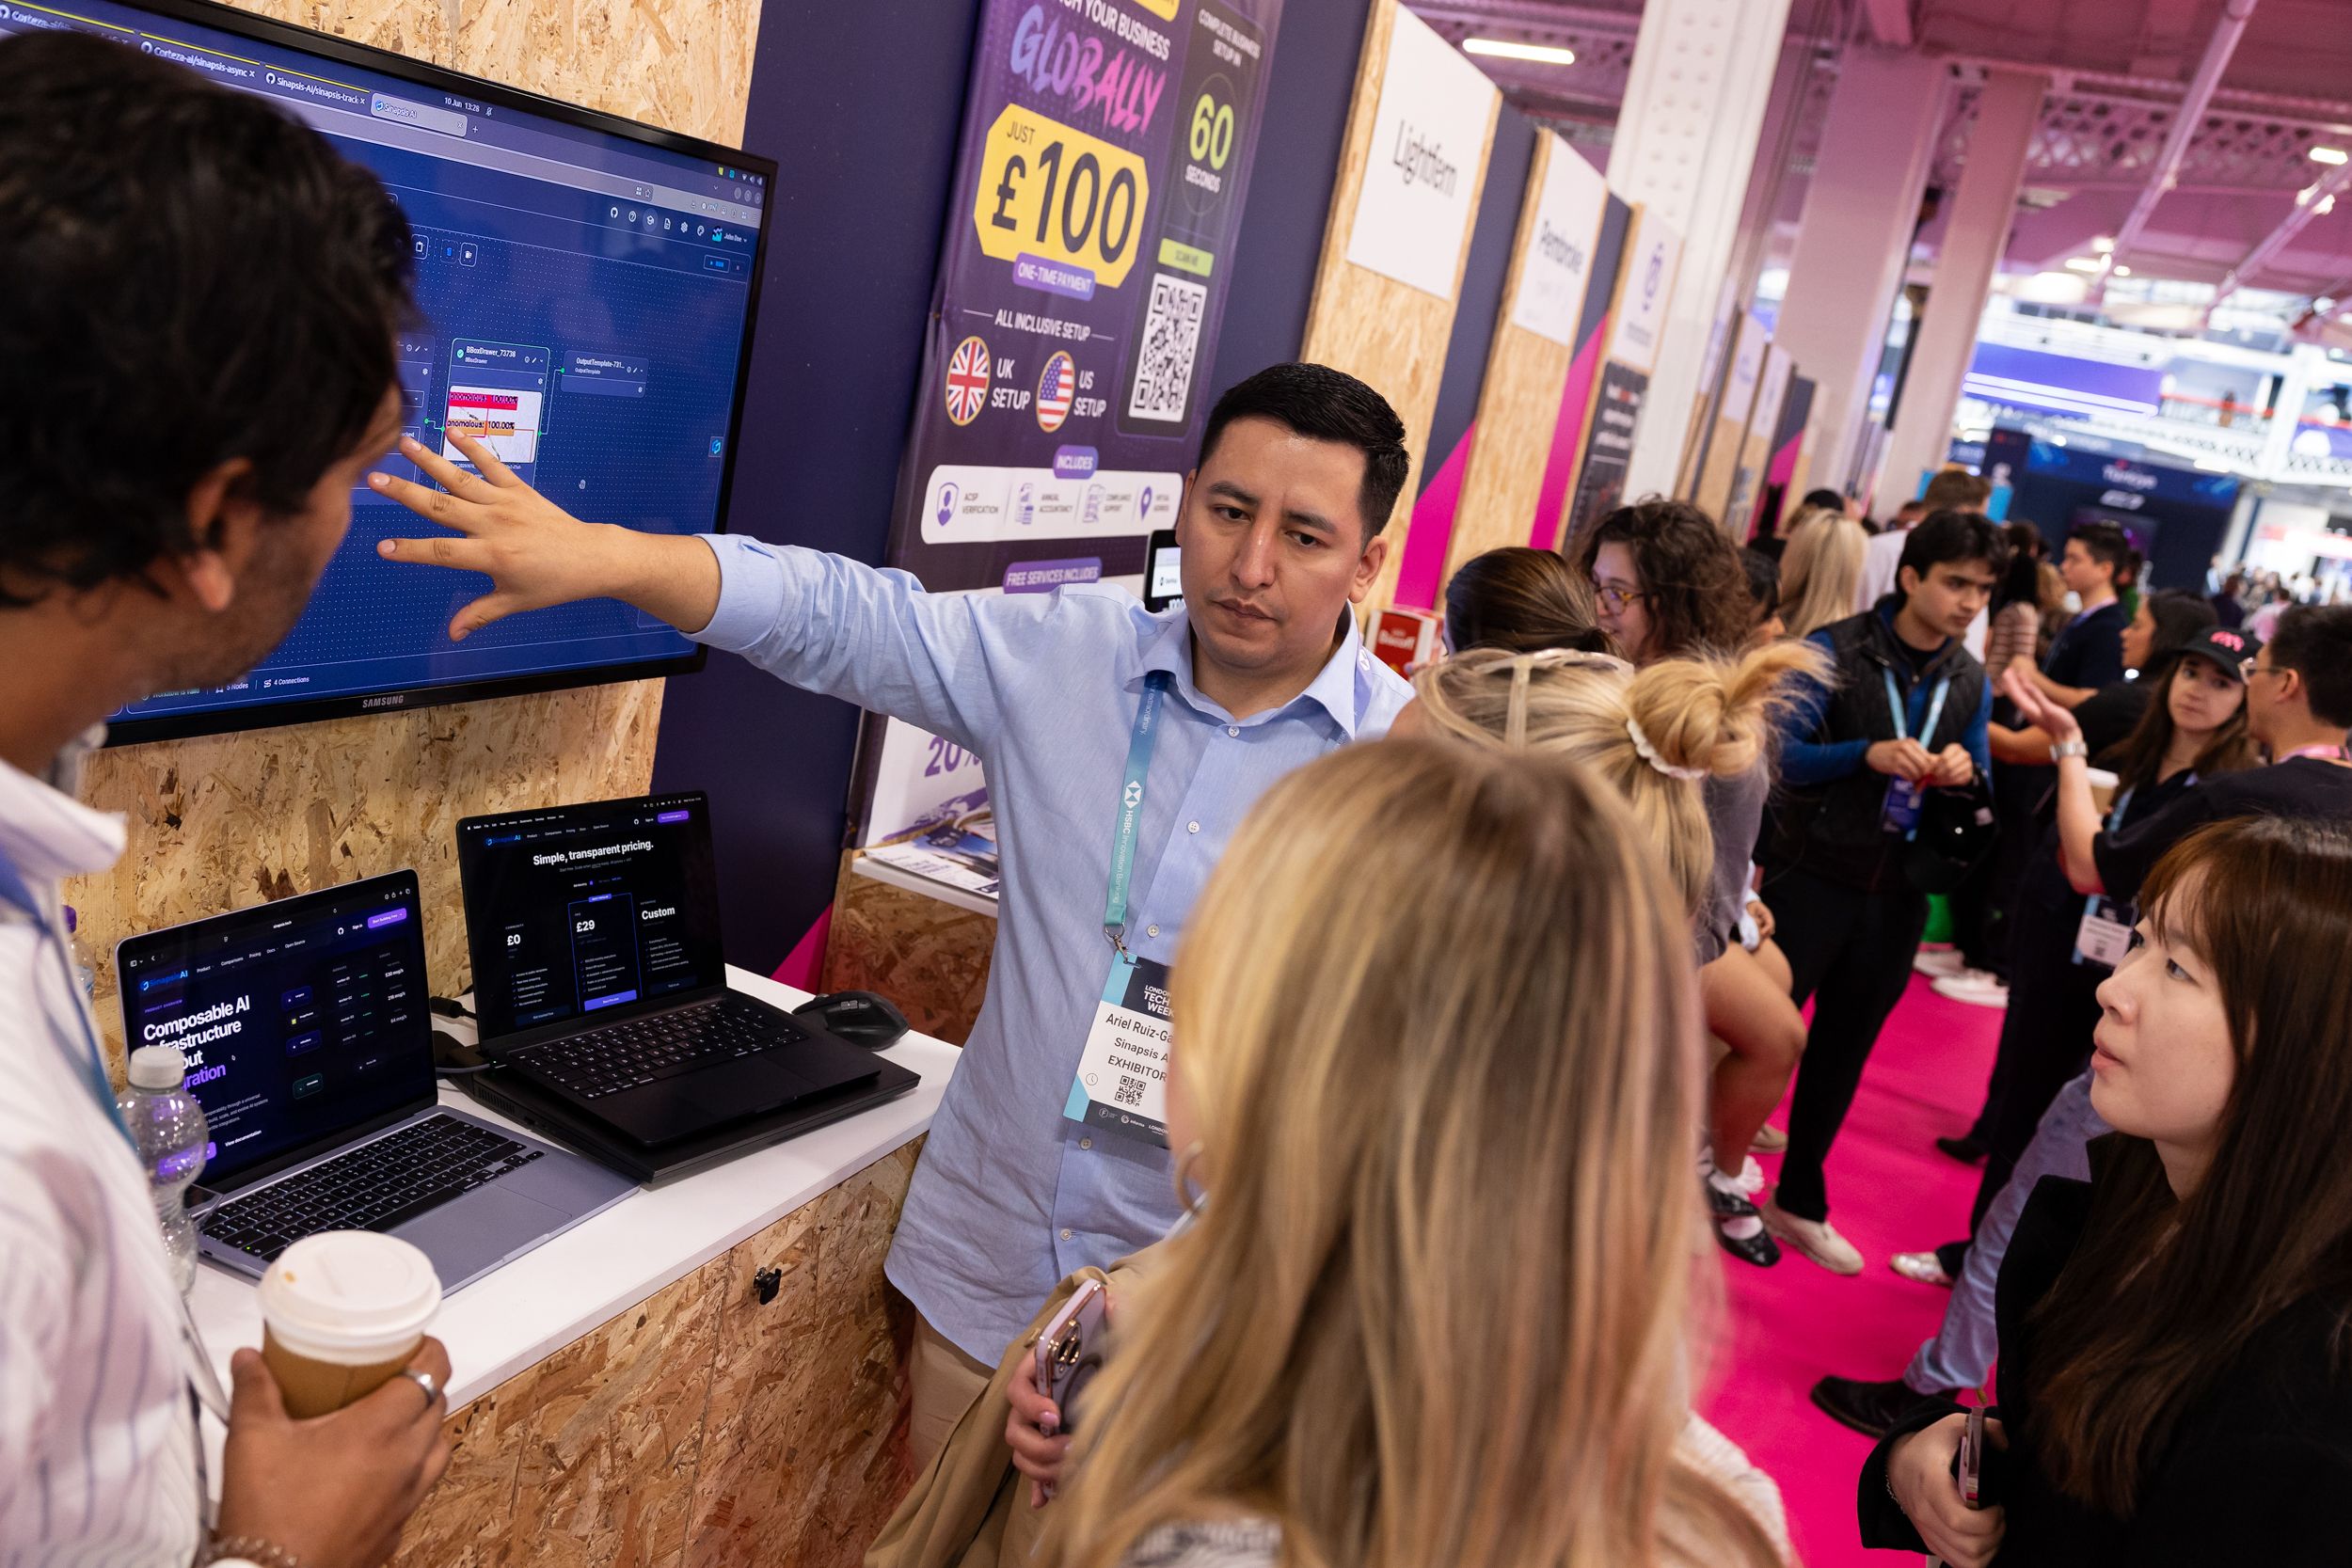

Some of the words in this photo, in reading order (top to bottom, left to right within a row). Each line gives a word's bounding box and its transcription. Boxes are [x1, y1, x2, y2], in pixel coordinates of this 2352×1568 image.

[1085, 0, 1118, 32] YOUR
[1117, 12, 1171, 61] BUSINESS
[1010, 8, 1167, 138] GLOBALLY
[444, 97, 452, 105] 10
[452, 99, 462, 108] Jun
[464, 101, 480, 113] 13:28
[1007, 120, 1036, 145] JUST
[1189, 94, 1234, 170] 60
[1185, 164, 1222, 194] SECONDS
[992, 140, 1136, 264] £100
[1017, 261, 1054, 286] ONE-TIME
[1054, 270, 1092, 293] PAYMENT
[994, 309, 1013, 328] ALL
[1014, 312, 1062, 337] INCLUSIVE
[1062, 320, 1091, 341] SETUP
[996, 358, 1015, 379] UK
[1078, 371, 1094, 390] US
[992, 387, 1031, 410] SETUP
[1073, 396, 1106, 418] SETUP
[487, 420, 515, 431] 100.00%
[1056, 455, 1093, 470] INCLUDES
[1007, 570, 1026, 587] FREE
[1026, 568, 1063, 585] SERVICES
[1063, 566, 1099, 581] INCLUDES
[230, 682, 249, 690] Nodes
[278, 676, 310, 686] Connections
[362, 694, 404, 709] SAMSUNG
[1123, 810, 1135, 834] HSBC
[532, 852, 568, 866] Simple,
[568, 844, 621, 860] transparent
[621, 840, 654, 855] pricing.
[642, 907, 675, 921] Custom
[576, 919, 596, 933] £29
[506, 934, 521, 946] £0
[1143, 990, 1170, 1006] TECH
[144, 1002, 234, 1041] Composable
[235, 994, 250, 1014] AI
[1147, 1001, 1175, 1018] WEEK
[1105, 1013, 1133, 1030] Ariel
[146, 1021, 242, 1051] frastructure
[1114, 1037, 1159, 1059] Sinapsis
[1107, 1054, 1168, 1082] EXHIBITOR
